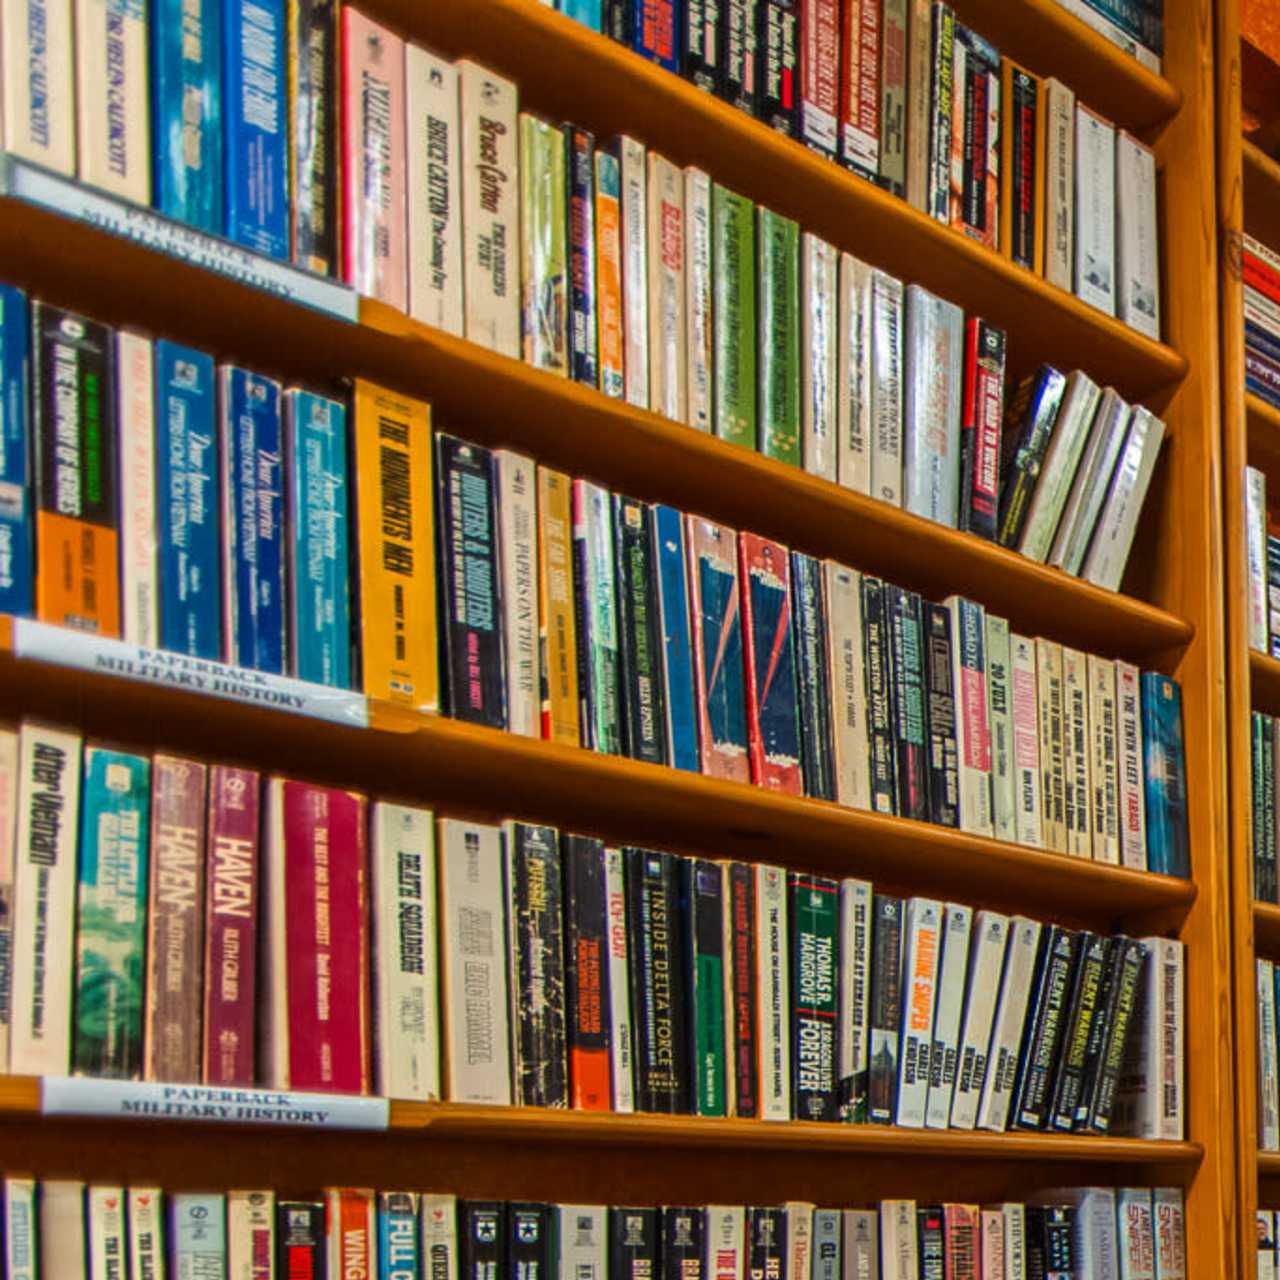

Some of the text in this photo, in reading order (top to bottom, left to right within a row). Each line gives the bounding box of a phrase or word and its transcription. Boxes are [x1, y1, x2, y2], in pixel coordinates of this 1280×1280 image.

[241, 2, 277, 134] NO ROOM FOR ERROR
[428, 115, 448, 162] BRUCE
[476, 117, 508, 214] Bruce Catton
[430, 164, 449, 220] CATTON
[479, 234, 493, 270] FURY
[491, 222, 506, 296] THE COMING
[379, 417, 413, 577] THE MONUMENTS MEN
[515, 543, 531, 597] PAPERS
[138, 648, 268, 686] PAPERBACK
[517, 625, 533, 656] THE
[95, 653, 306, 709] MILITARY HISTORY
[518, 659, 534, 692] WAR
[990, 664, 1006, 714] 20 JULY
[1124, 696, 1141, 832] THE TENTH FLEET FARAGO
[30, 743, 64, 866] After Vietnam
[214, 836, 251, 1002] HAVEN RUTH GRUBER
[397, 852, 423, 975] DEATH SQUADRON
[652, 891, 673, 1066] INSIDE DELTA FORCE
[800, 933, 816, 1004] HARGROVE
[815, 937, 832, 1005] THOMAS R.
[911, 930, 937, 1030] MARINE SNIPER
[464, 961, 493, 1066] ERIC HAMMEL
[800, 1019, 820, 1090] FOREVER
[905, 1036, 920, 1084] HENDERSON
[917, 1044, 930, 1080] CHARLES
[120, 1099, 330, 1123] MILITARY HISTORY
[163, 1087, 291, 1105] PAPERBACK
[344, 1230, 366, 1280] WING
[390, 1220, 413, 1265] FULL
[716, 1248, 735, 1270] THE
[764, 1257, 780, 1277] HE
